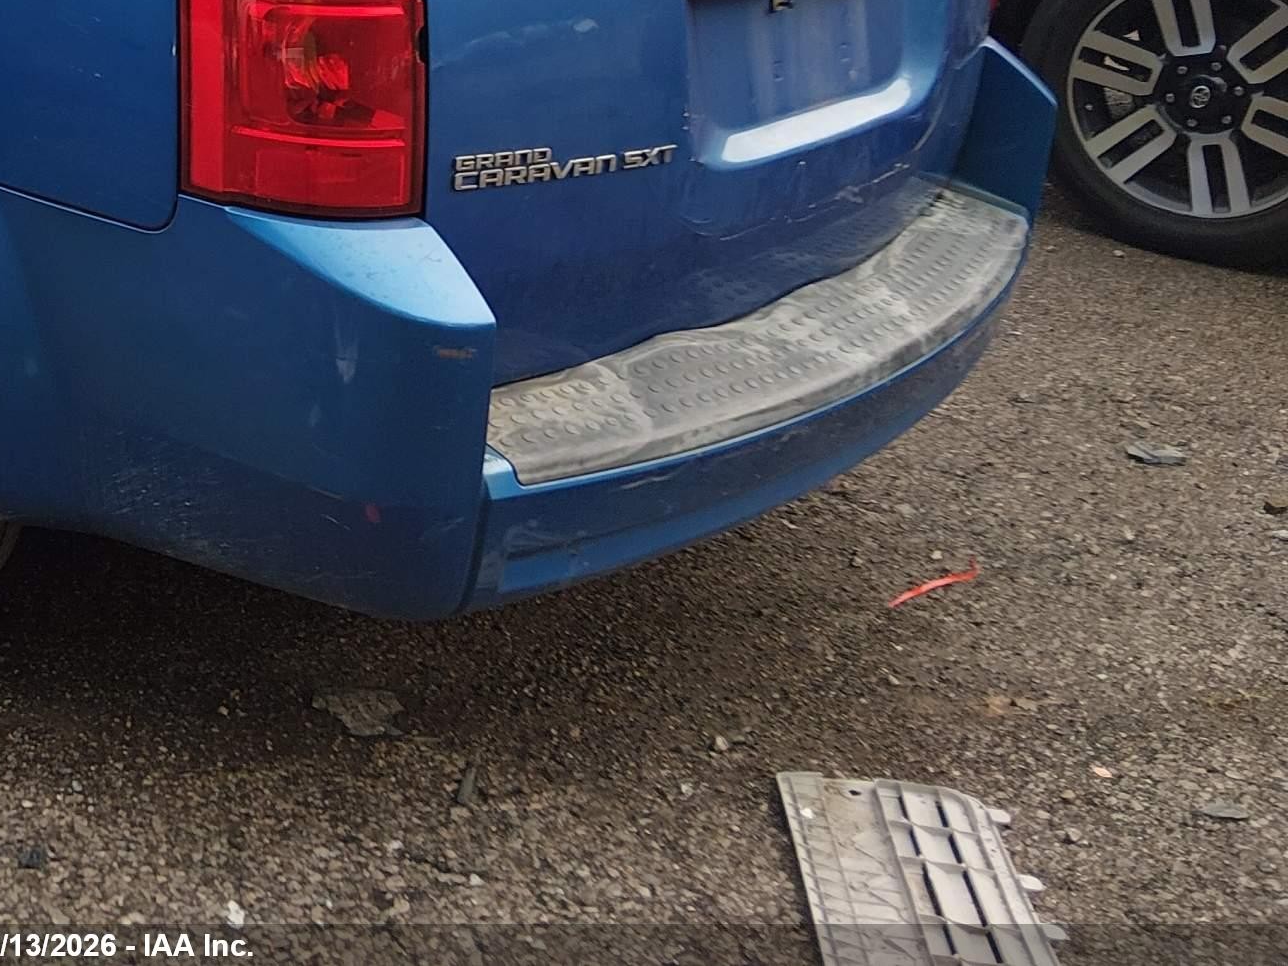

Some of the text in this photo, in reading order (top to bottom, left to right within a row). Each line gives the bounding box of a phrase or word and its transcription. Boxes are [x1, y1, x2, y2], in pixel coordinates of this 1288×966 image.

[453, 143, 679, 191] CARAVAN SXT
[454, 147, 552, 172] GRAND
